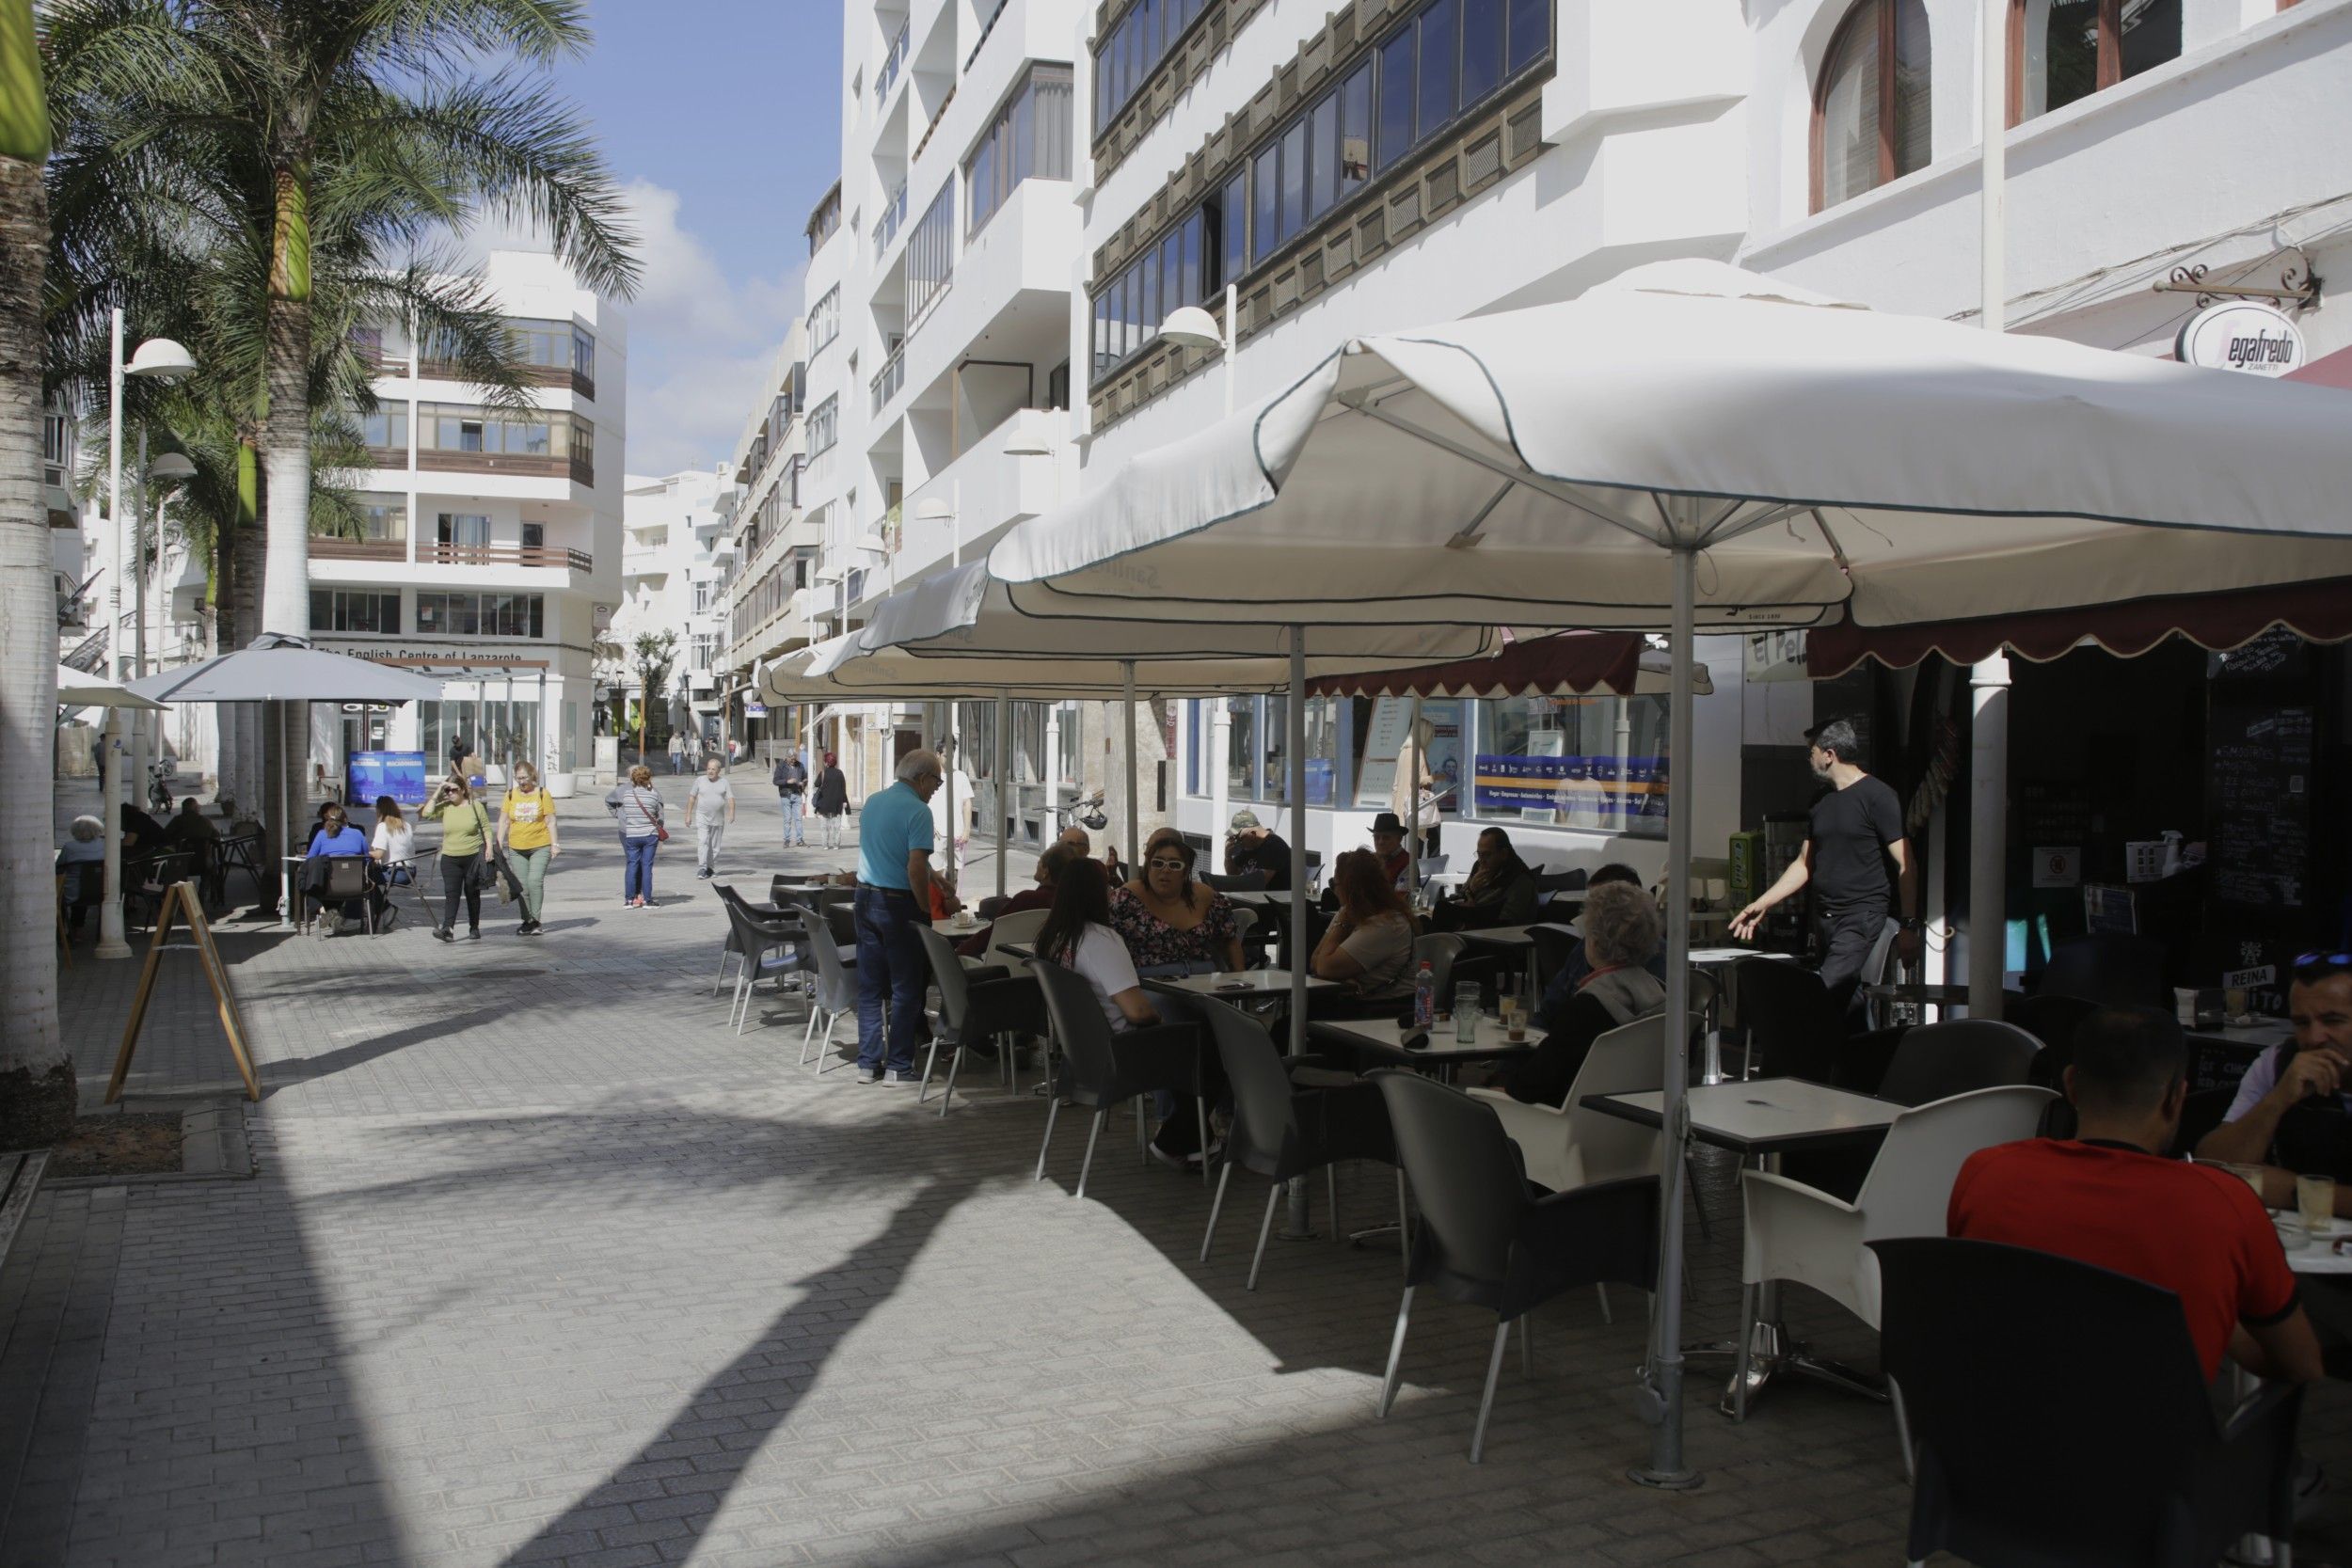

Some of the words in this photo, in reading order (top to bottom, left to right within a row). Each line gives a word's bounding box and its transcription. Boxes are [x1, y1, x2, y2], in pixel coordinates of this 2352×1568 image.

[347, 648, 392, 659] English
[399, 649, 438, 659] Centre
[445, 651, 456, 659] of
[462, 651, 521, 661] Lanzarote
[2231, 969, 2267, 988] REINA
